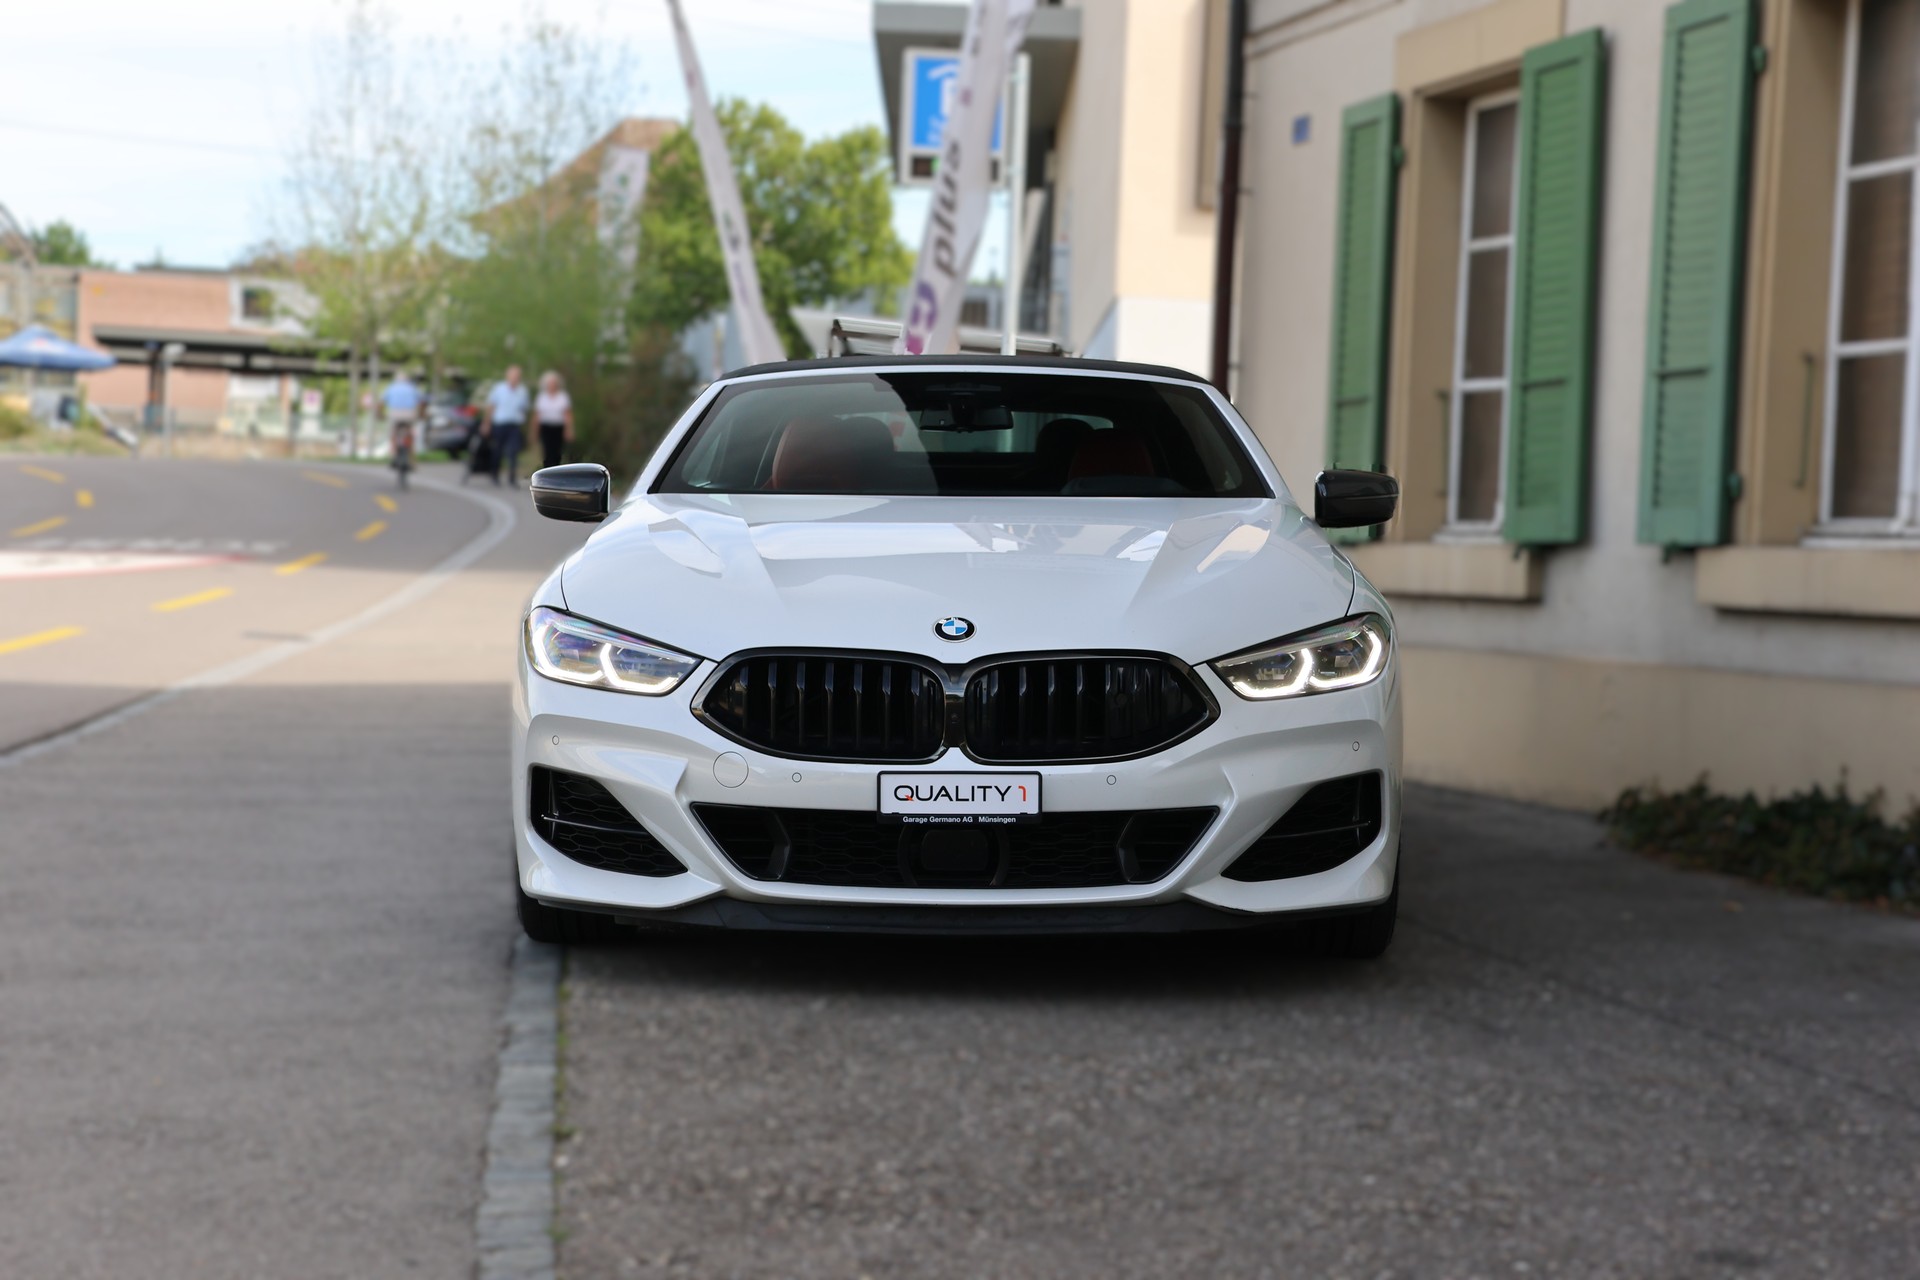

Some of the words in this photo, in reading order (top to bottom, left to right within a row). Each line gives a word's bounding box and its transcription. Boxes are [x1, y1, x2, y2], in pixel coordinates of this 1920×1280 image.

[894, 785, 1012, 802] QUALITY
[902, 816, 928, 824] Garage
[978, 816, 1016, 824] Münsingen
